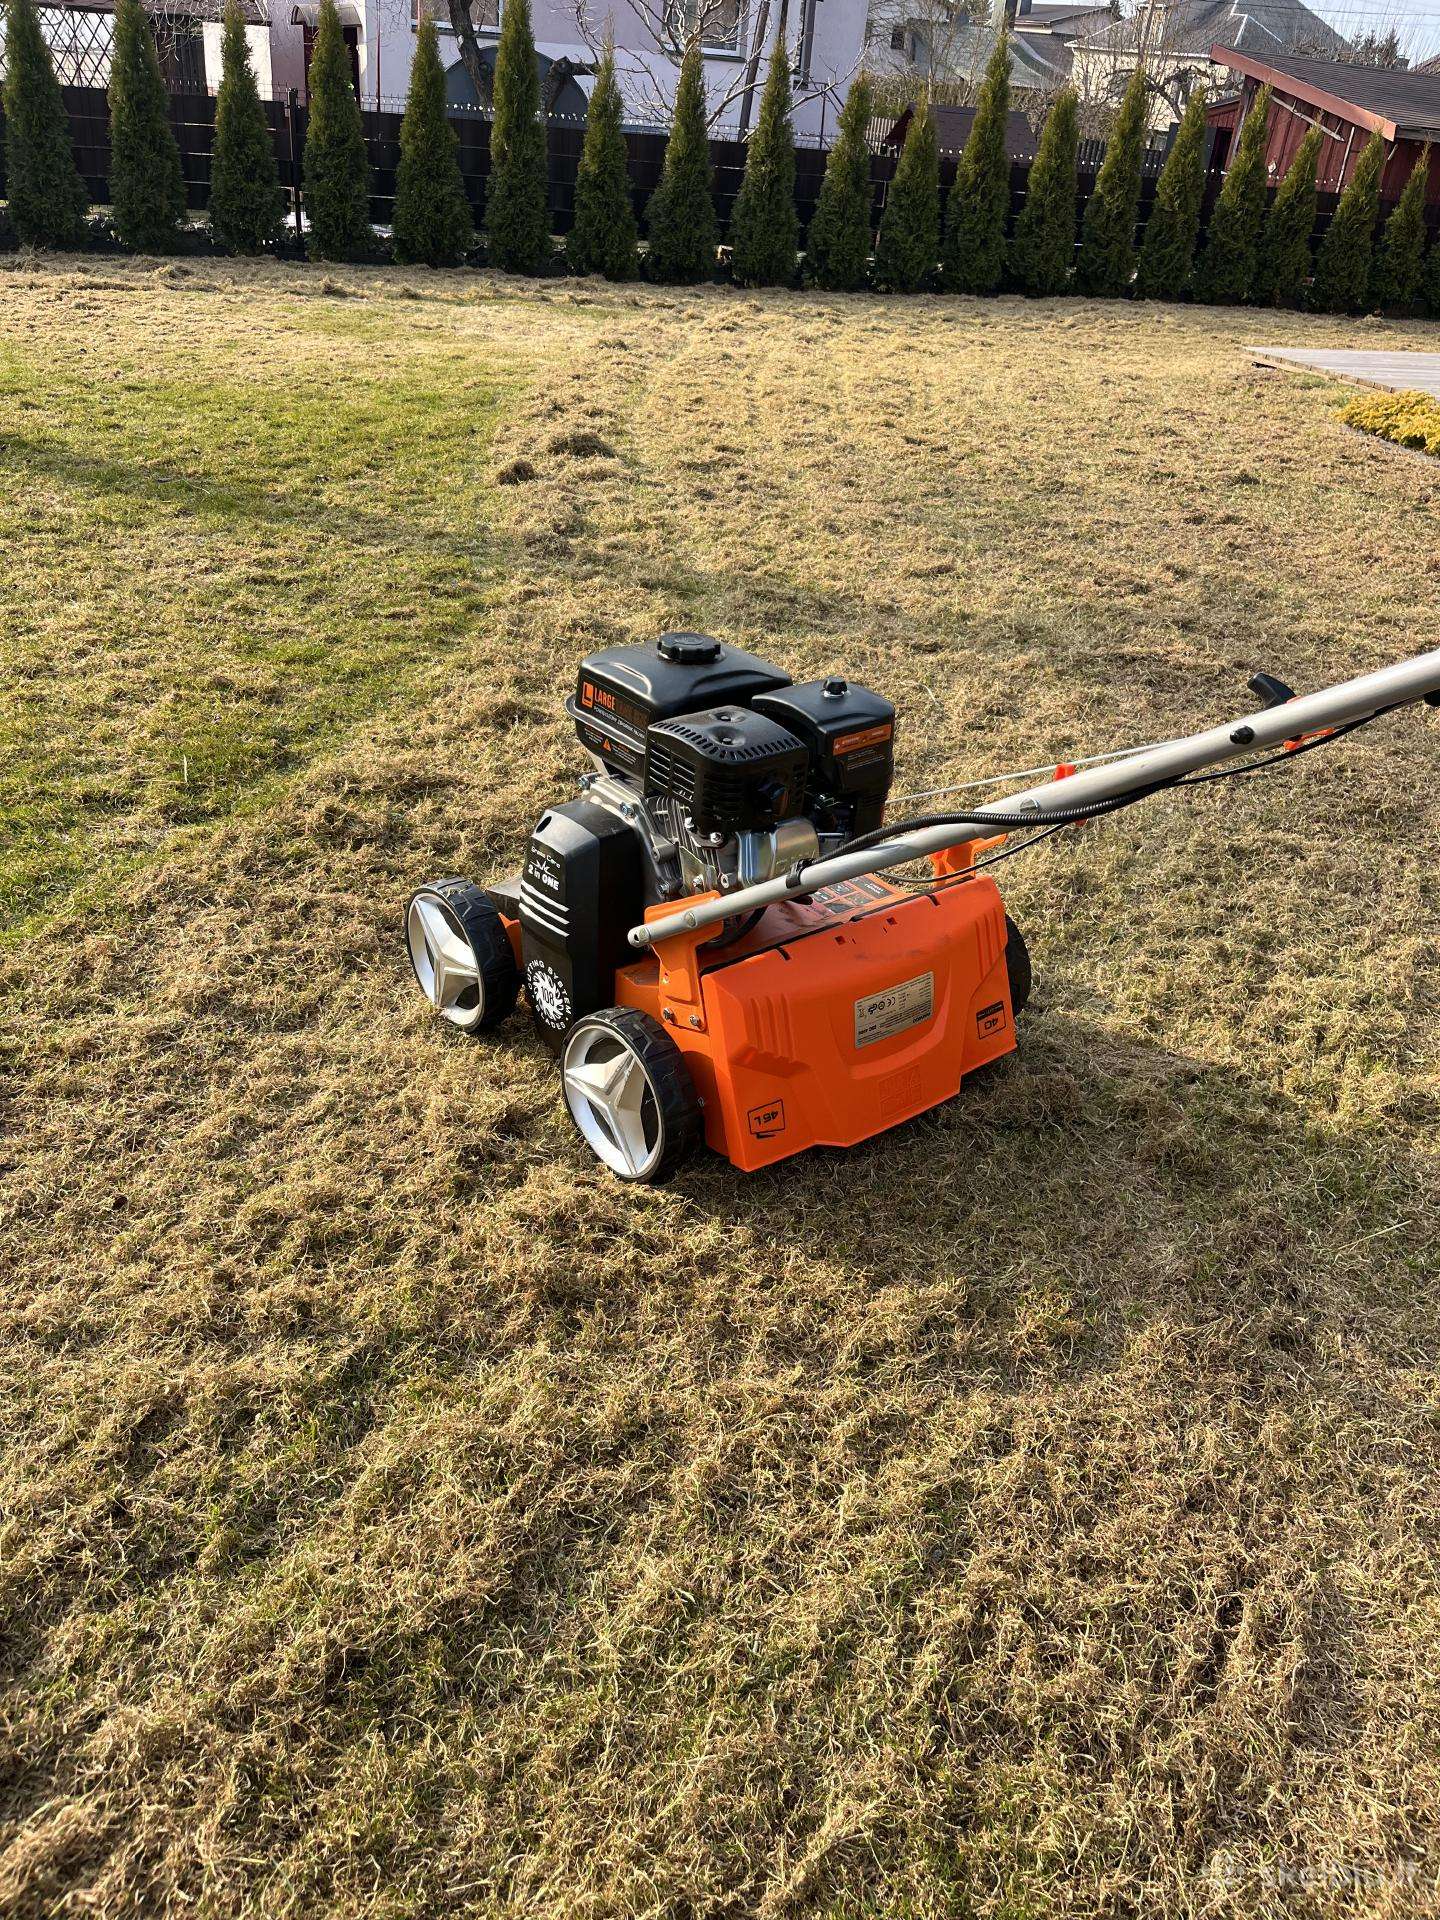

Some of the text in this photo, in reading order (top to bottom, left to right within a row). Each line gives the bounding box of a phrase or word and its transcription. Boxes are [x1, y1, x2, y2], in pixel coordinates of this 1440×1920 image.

[594, 688, 616, 711] LARGE
[528, 864, 560, 891] 2 in ONE
